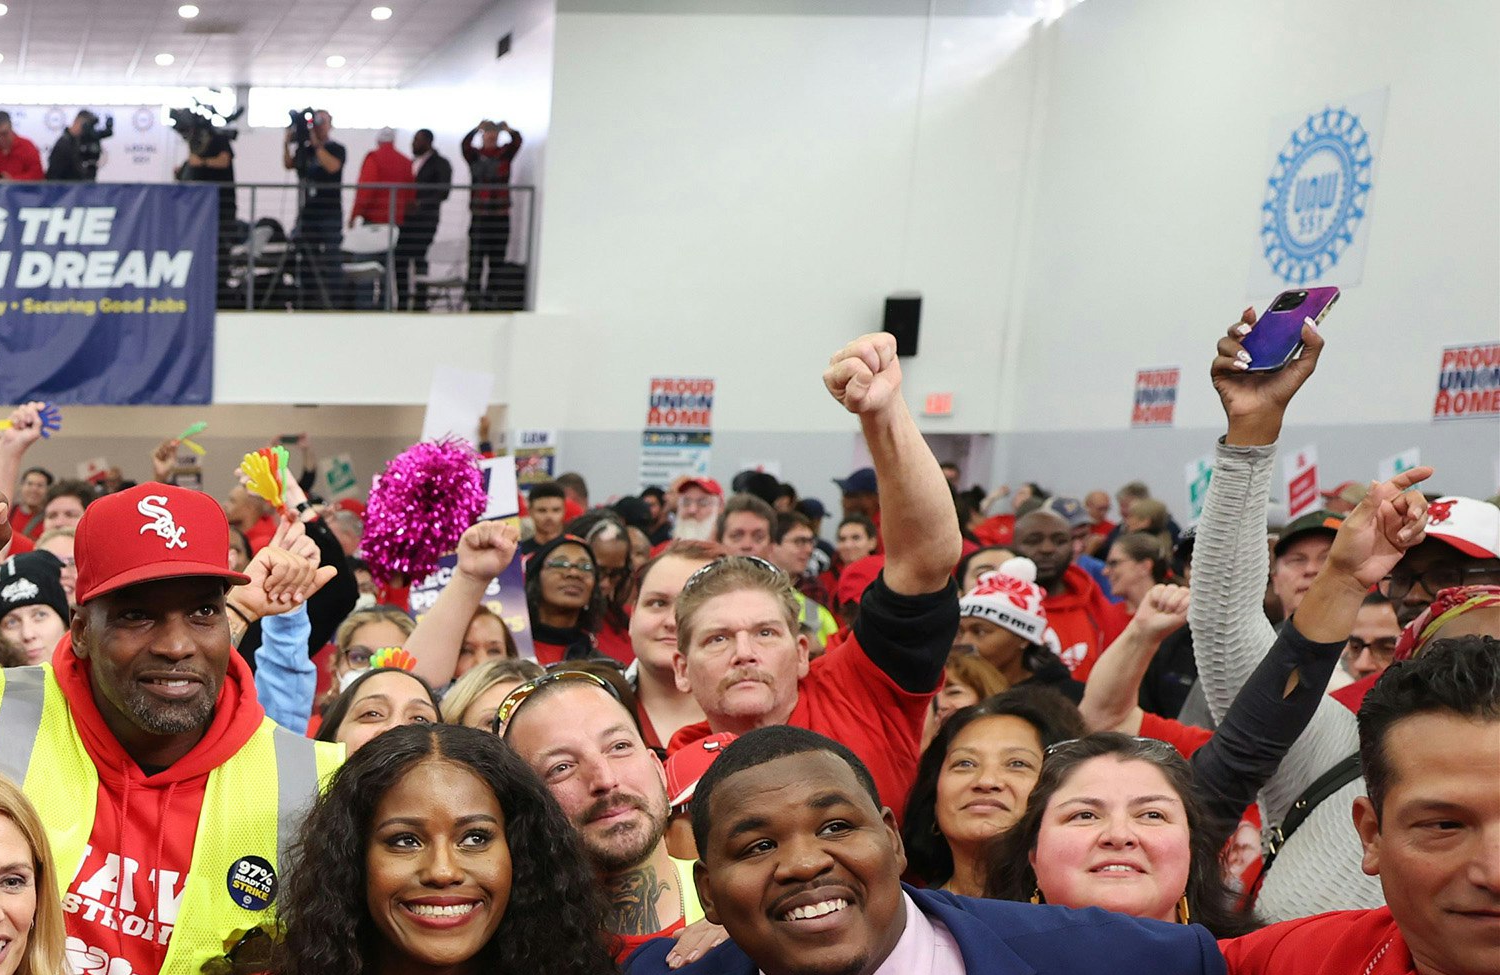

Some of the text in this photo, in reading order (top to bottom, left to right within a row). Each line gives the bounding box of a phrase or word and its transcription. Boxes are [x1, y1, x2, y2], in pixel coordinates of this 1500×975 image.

[1294, 172, 1339, 213] UAW
[18, 207, 117, 245] THE
[15, 250, 193, 288] DREAM
[22, 297, 96, 316] Securing
[99, 298, 144, 313] Good
[148, 298, 187, 313] Jobs
[1442, 346, 1500, 369] PROU
[650, 378, 715, 394] PROUD
[1136, 369, 1180, 386] PROUD
[649, 394, 714, 409] UNION
[1134, 387, 1177, 405] UNION
[961, 604, 1036, 633] upreme
[72, 844, 188, 925] AW
[235, 873, 271, 893] READY TO
[238, 861, 274, 886] 97%
[232, 880, 269, 901] STRIKE
[62, 892, 174, 945] STRON
